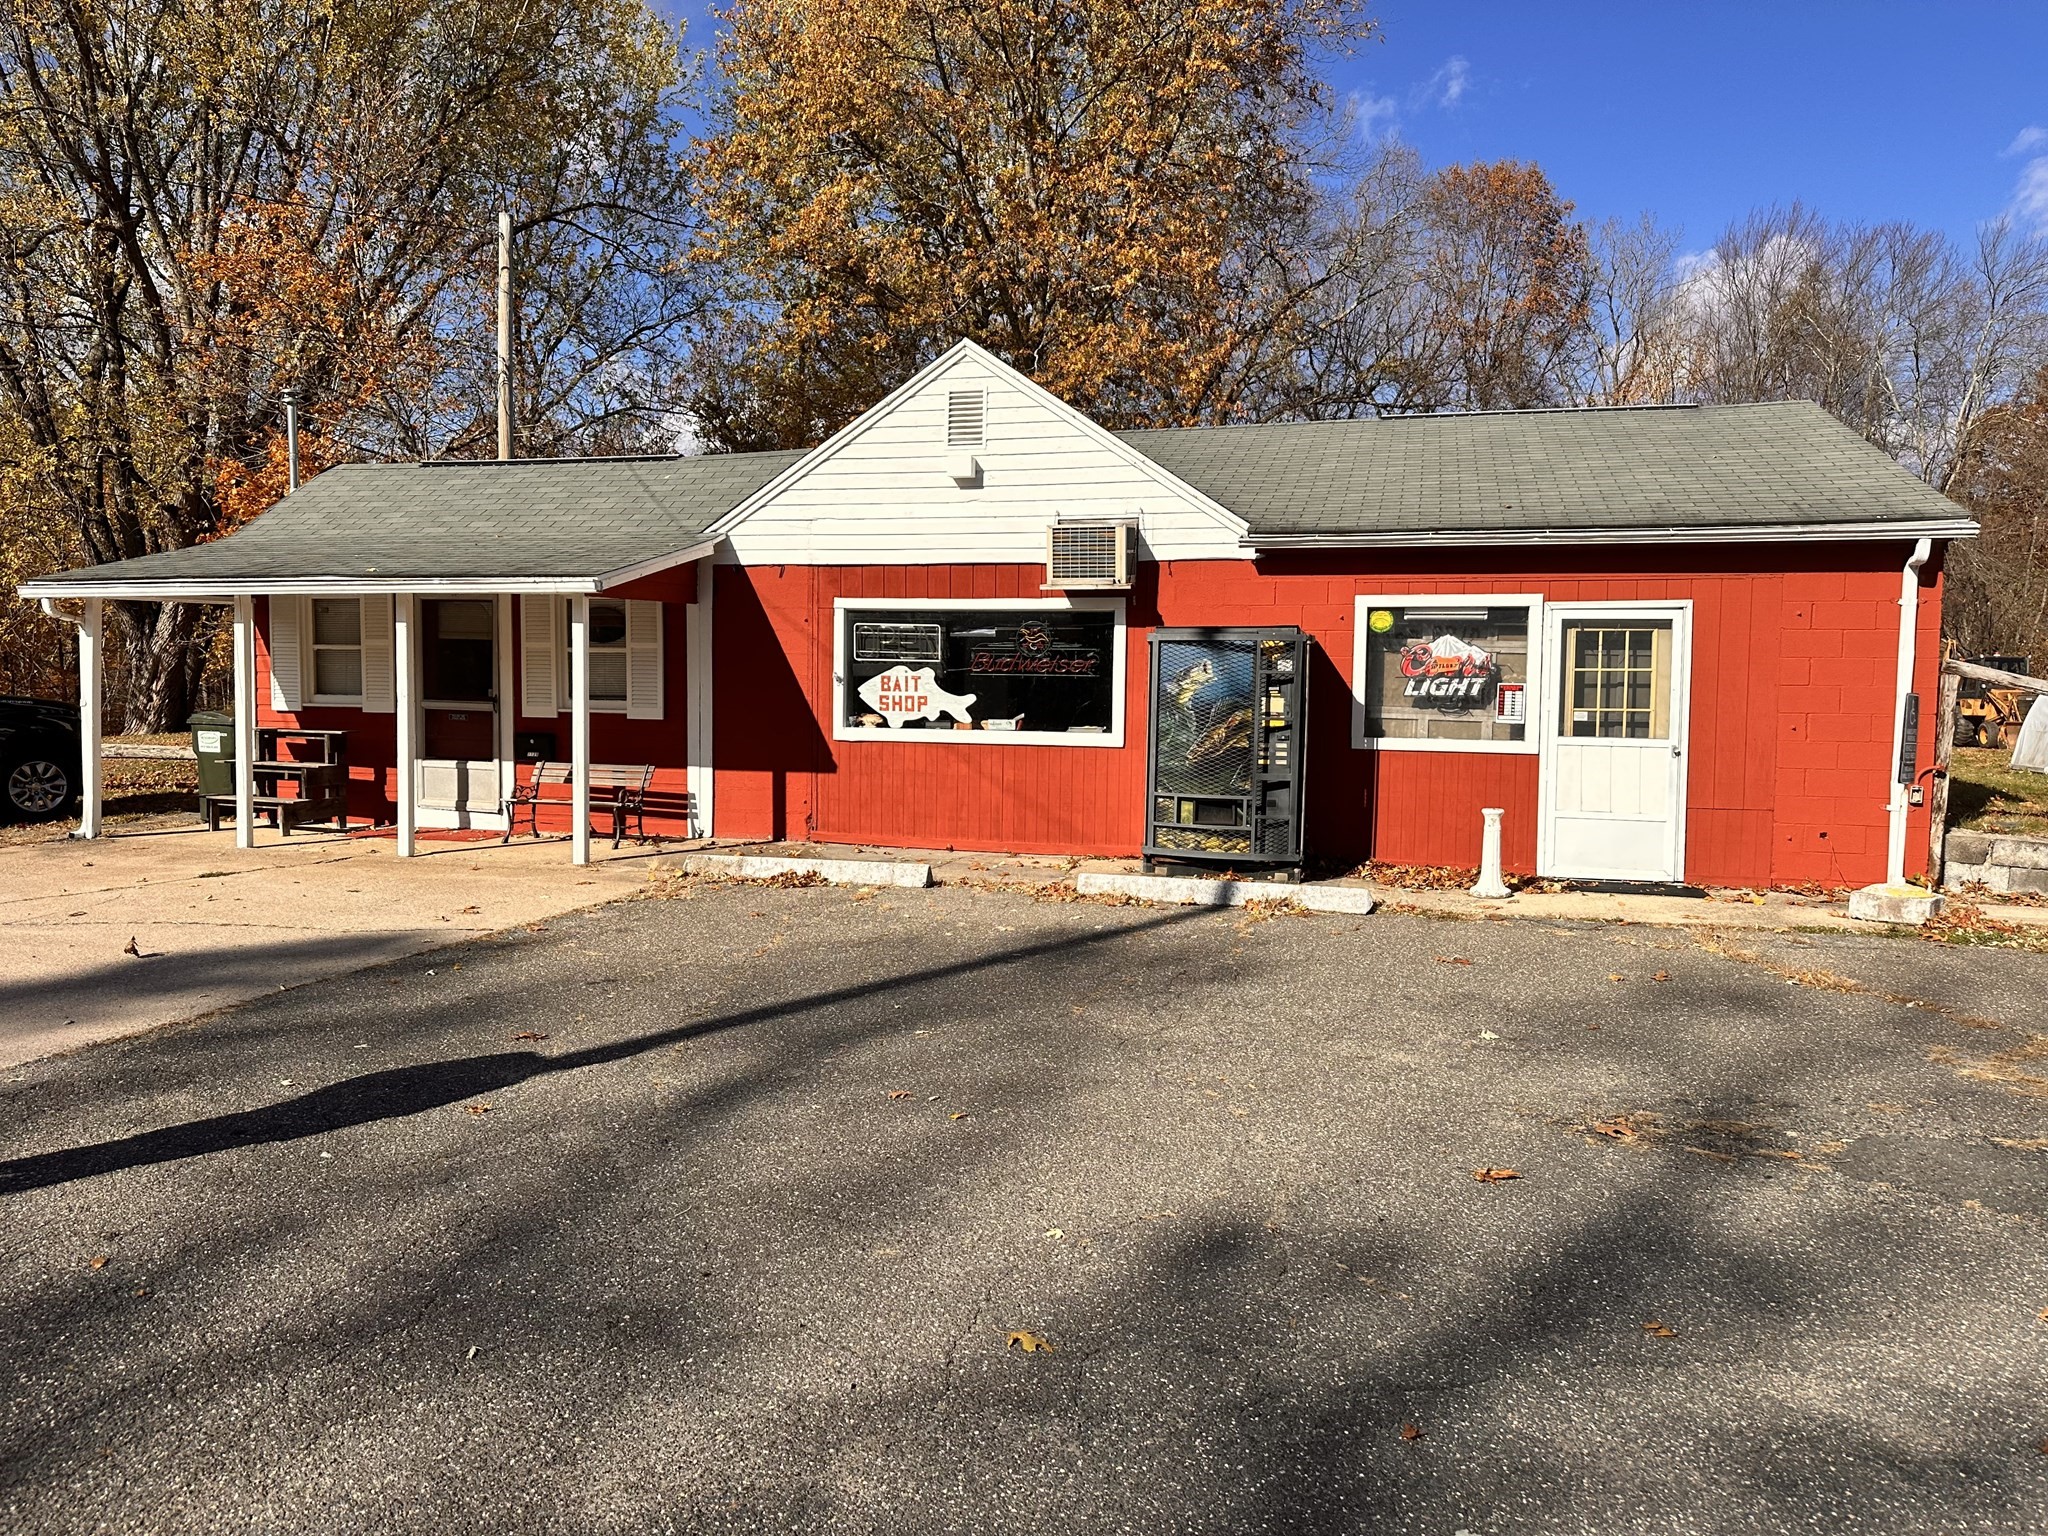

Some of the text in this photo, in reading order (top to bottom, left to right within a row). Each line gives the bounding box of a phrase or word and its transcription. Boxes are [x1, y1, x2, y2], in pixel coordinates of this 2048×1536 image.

[969, 651, 1097, 673] Budweiser
[880, 675, 922, 692] BAIT
[1403, 677, 1487, 696] LIGHT
[878, 694, 928, 712] SHOP
